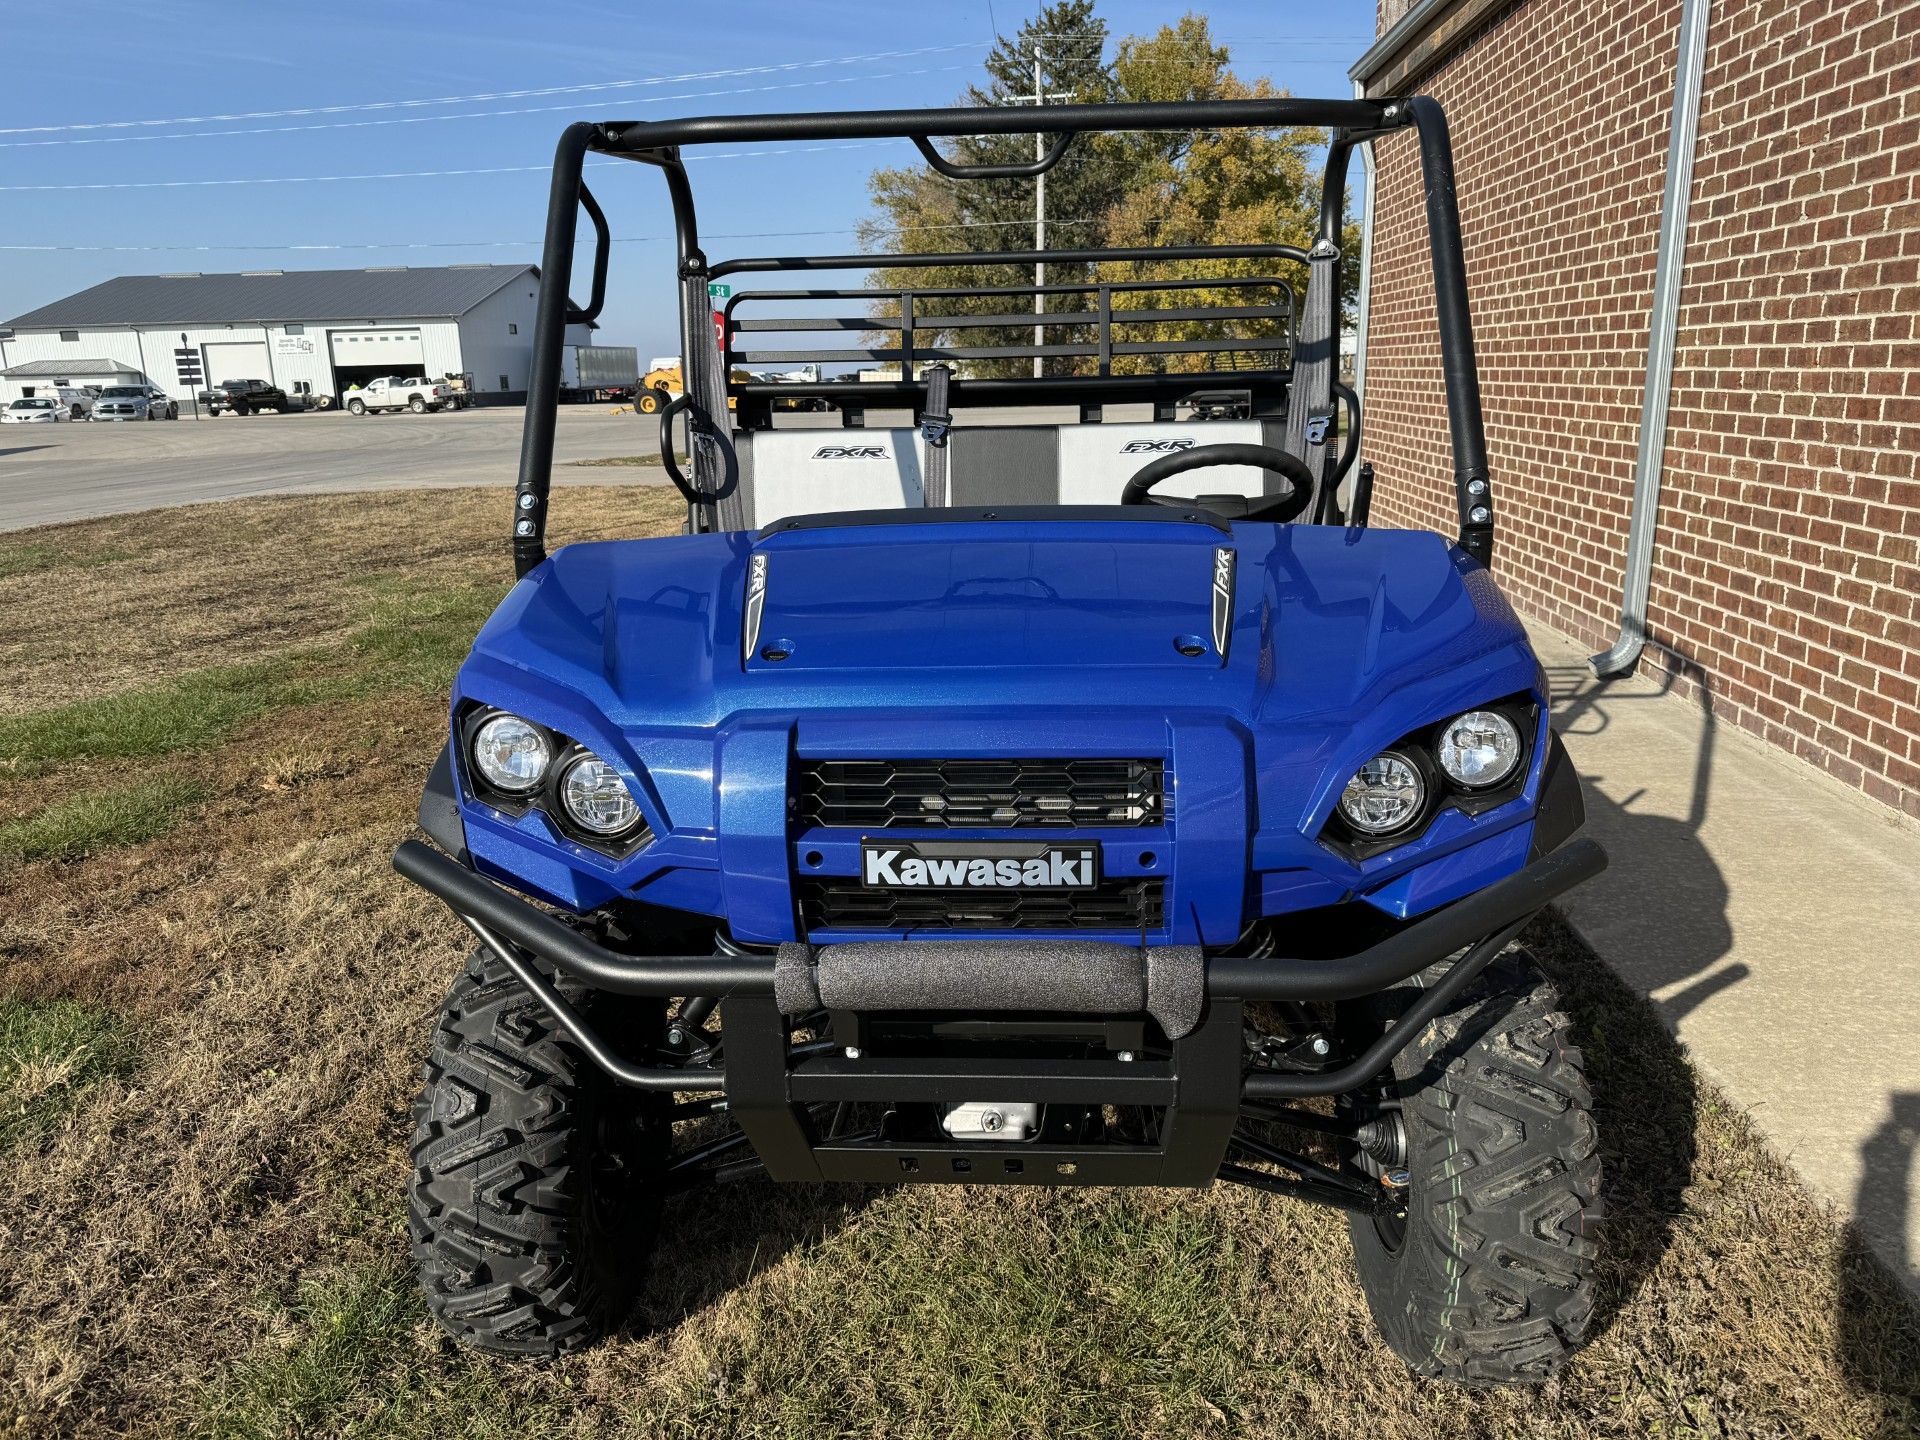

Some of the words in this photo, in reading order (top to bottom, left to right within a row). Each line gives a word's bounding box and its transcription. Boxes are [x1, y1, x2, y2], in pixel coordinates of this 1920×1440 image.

[715, 286, 725, 296] St
[814, 446, 887, 459] FXR
[1121, 438, 1195, 453] FXR
[750, 554, 767, 594] FXR
[1216, 548, 1231, 590] FXR
[866, 850, 1093, 887] Kawasaki
